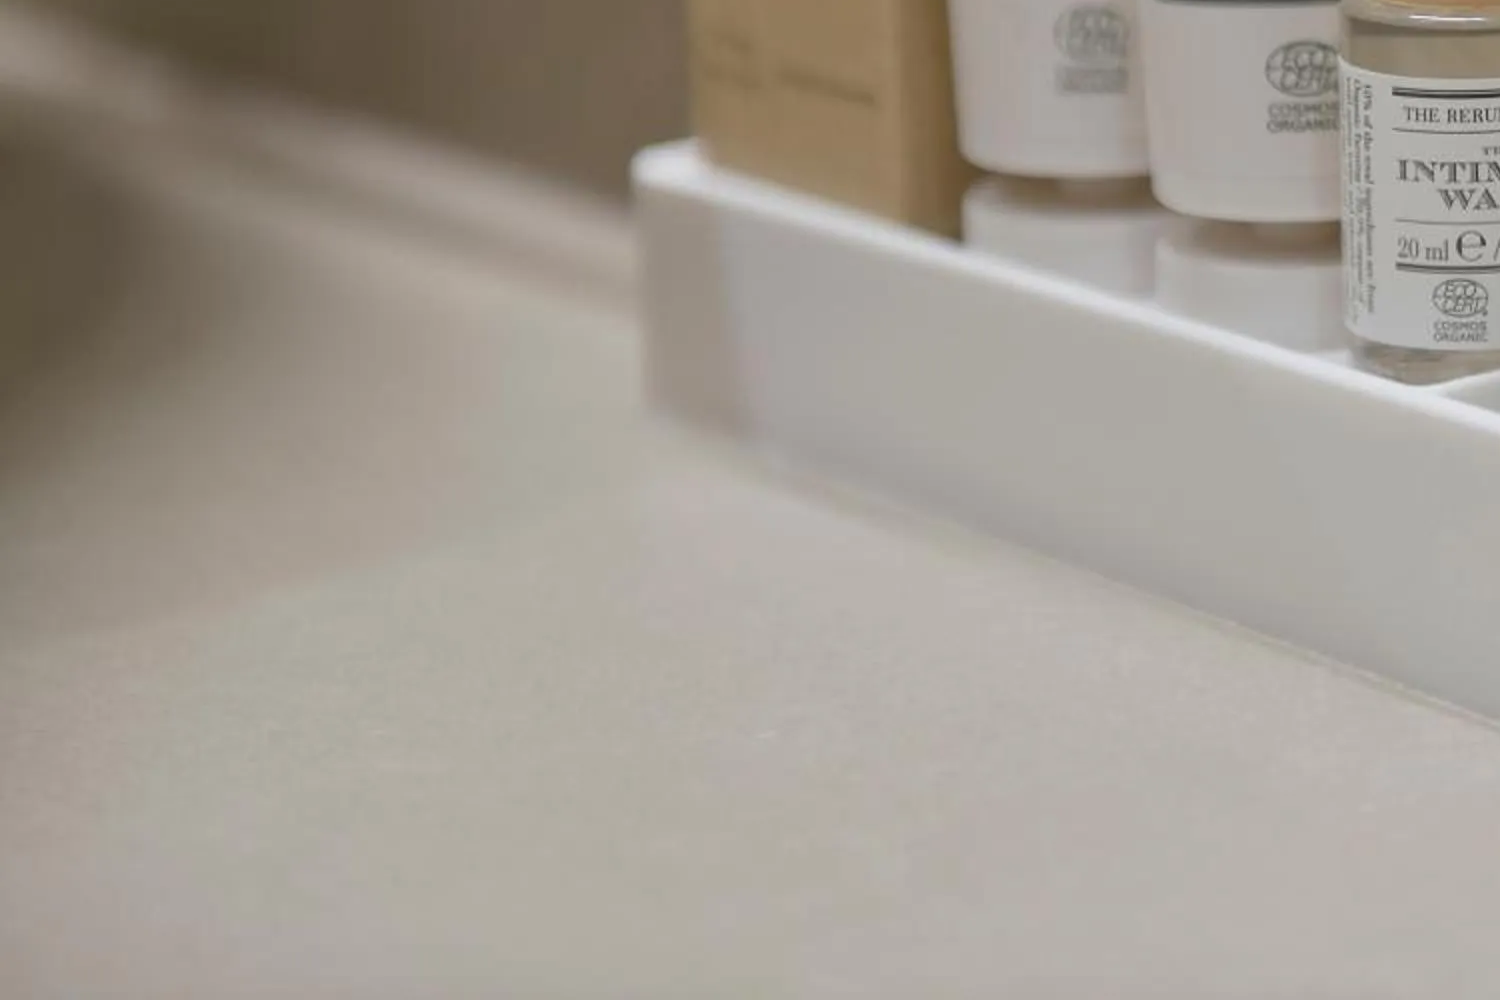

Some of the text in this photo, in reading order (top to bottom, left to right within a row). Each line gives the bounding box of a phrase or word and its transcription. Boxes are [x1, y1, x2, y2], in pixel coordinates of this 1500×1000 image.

[1402, 105, 1441, 124] THE
[1397, 236, 1419, 259] 20
[1425, 237, 1449, 261] ml
